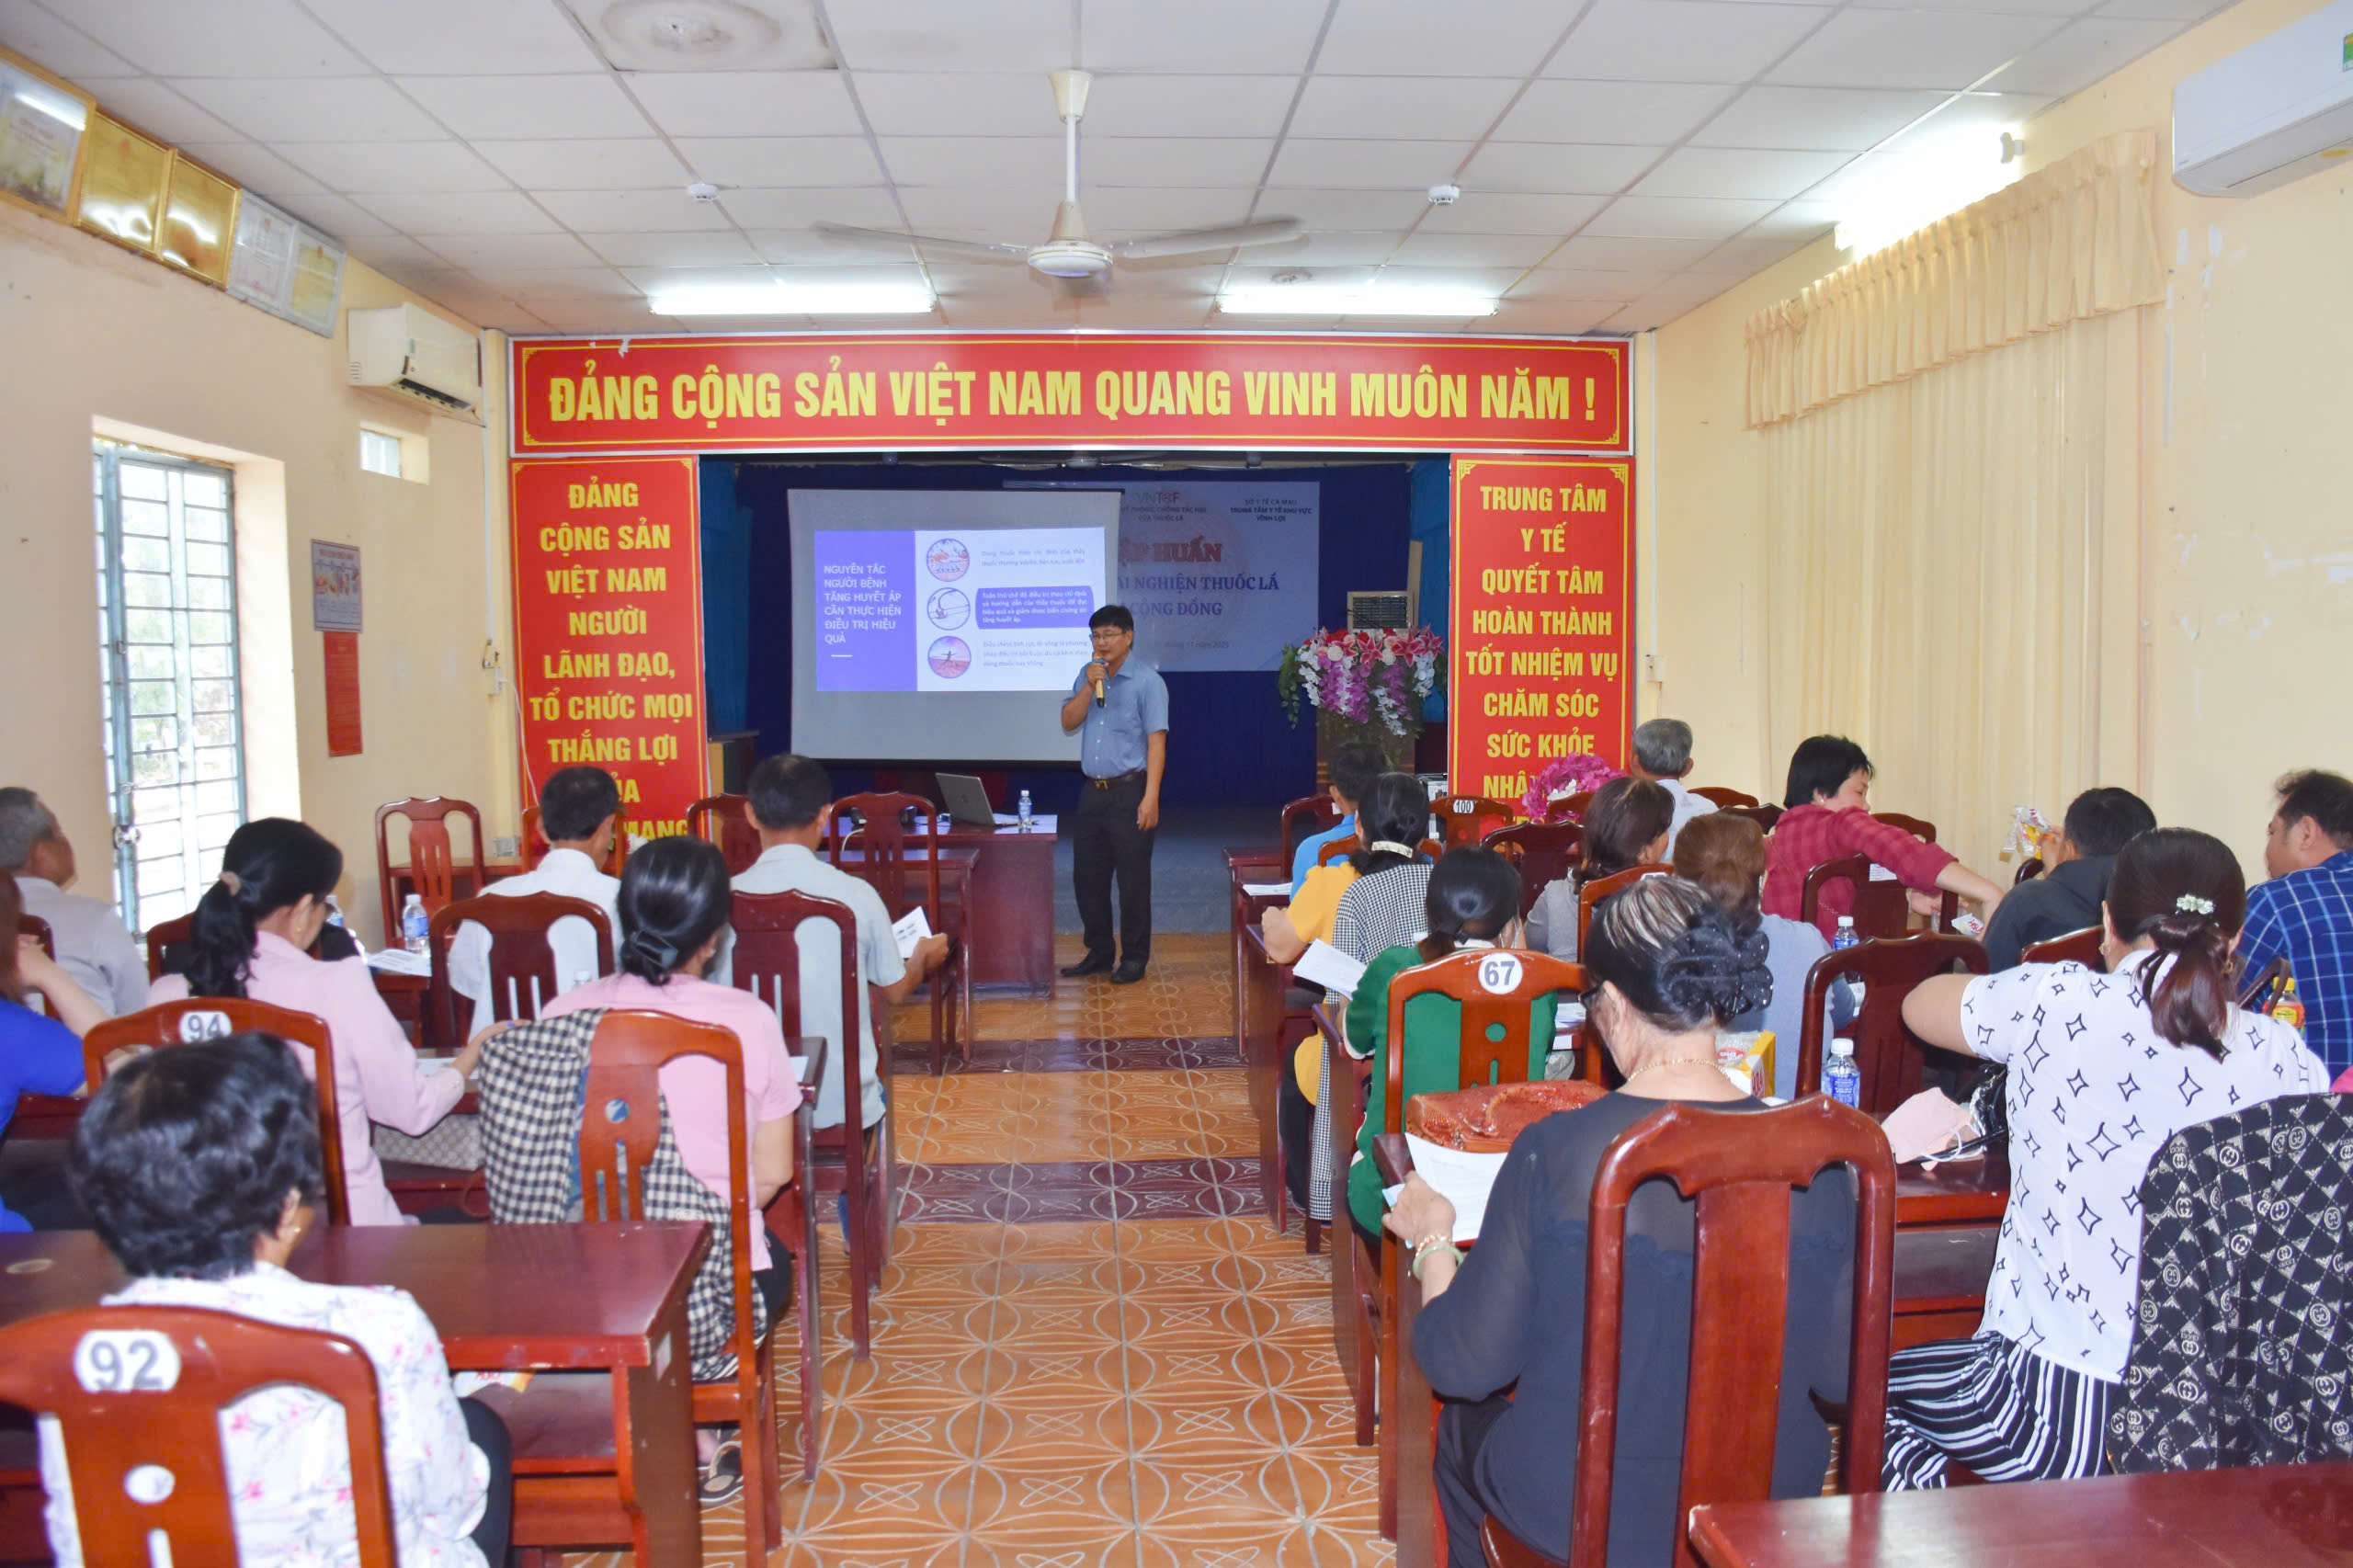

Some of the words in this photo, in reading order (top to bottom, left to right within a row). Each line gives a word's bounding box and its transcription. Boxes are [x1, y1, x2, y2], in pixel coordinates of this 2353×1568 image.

[550, 360, 658, 421] ĐẢNG
[672, 364, 781, 428] CỘNG
[796, 356, 876, 417] SẢN
[890, 363, 976, 426] VIỆT
[989, 370, 1081, 415] NAM
[1096, 371, 1230, 419] QUANG
[1245, 372, 1336, 416] VINH
[1351, 364, 1467, 418] MUÔN
[1481, 368, 1569, 419] NĂM
[1586, 378, 1594, 420] !
[569, 476, 638, 507] ĐẢNG
[1480, 485, 1552, 511] TRUNG
[1560, 483, 1606, 512] TÂM
[540, 522, 609, 556] CỘNG
[618, 517, 670, 550] SẢN
[1522, 528, 1534, 551] Y
[1540, 522, 1566, 551] TẾ
[547, 564, 599, 598] VIỆT
[608, 567, 666, 592] NAM
[1131, 574, 1196, 594] NGHIỆN
[1200, 573, 1256, 590] THUỐC
[1259, 572, 1279, 589] LÁ
[1483, 564, 1550, 596] QUYẾT
[1557, 566, 1603, 594] TÂM
[1177, 597, 1222, 616] ĐỒNG
[570, 608, 647, 635] NGƯỜI
[1473, 608, 1532, 634] HOÀN
[1540, 608, 1611, 635] THÀNH
[545, 650, 609, 678] LÃNH
[618, 652, 675, 682] ĐẠO,
[1467, 644, 1505, 675] TỐT
[1512, 647, 1583, 680] NHIỆM
[1591, 653, 1617, 681] VỤ
[529, 687, 562, 721] TỔ
[569, 692, 635, 720] CHỨC
[644, 694, 692, 723] MỌI
[1484, 688, 1548, 716] CHĂM
[1556, 688, 1598, 717] SÓC
[548, 731, 631, 762] THẮNG
[639, 735, 676, 765] LỢI
[1487, 733, 1529, 757] SỨC
[1539, 728, 1594, 757] KHỎE
[1483, 770, 1534, 798] NHÂ
[1456, 800, 1471, 813] 100
[1484, 961, 1515, 986] 67
[188, 1014, 222, 1042] 94
[90, 1338, 164, 1390] 92
